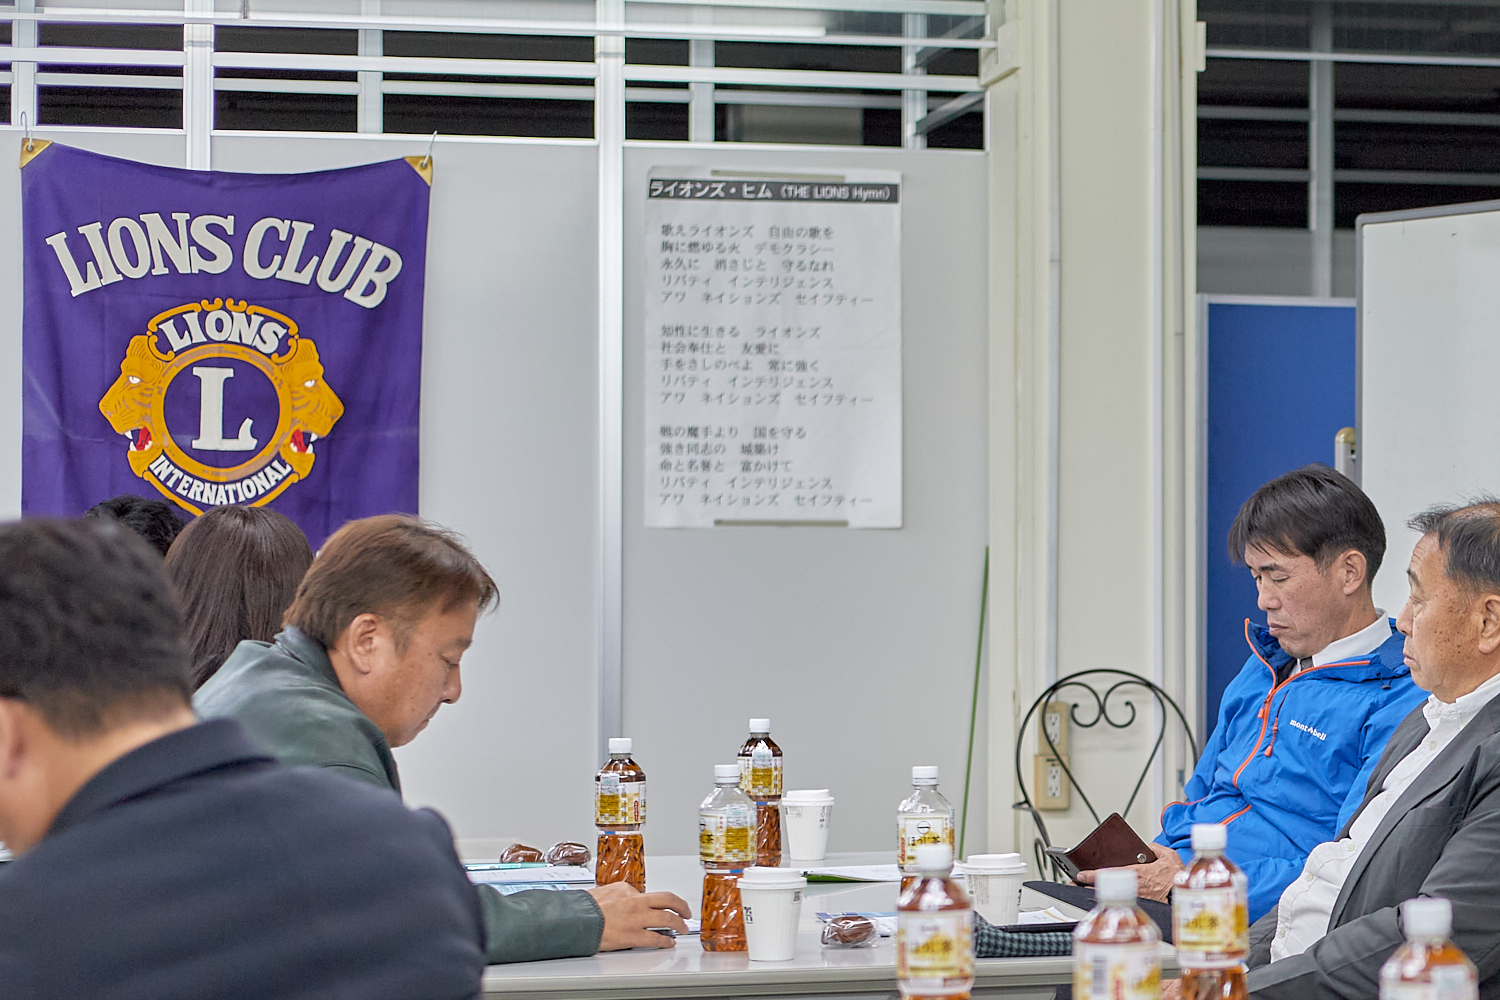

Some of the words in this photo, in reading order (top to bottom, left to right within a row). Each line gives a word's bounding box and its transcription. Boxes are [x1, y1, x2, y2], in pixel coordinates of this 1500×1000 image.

[650, 182, 773, 198] ライオンズ・ヒム
[813, 185, 850, 198] LIONS
[46, 212, 235, 297] LIONS
[243, 217, 403, 309] CLUB
[158, 310, 287, 353] LIONS
[757, 326, 821, 339] ライオンズ
[192, 366, 258, 451] L
[149, 455, 291, 505] INTERNATIONAL
